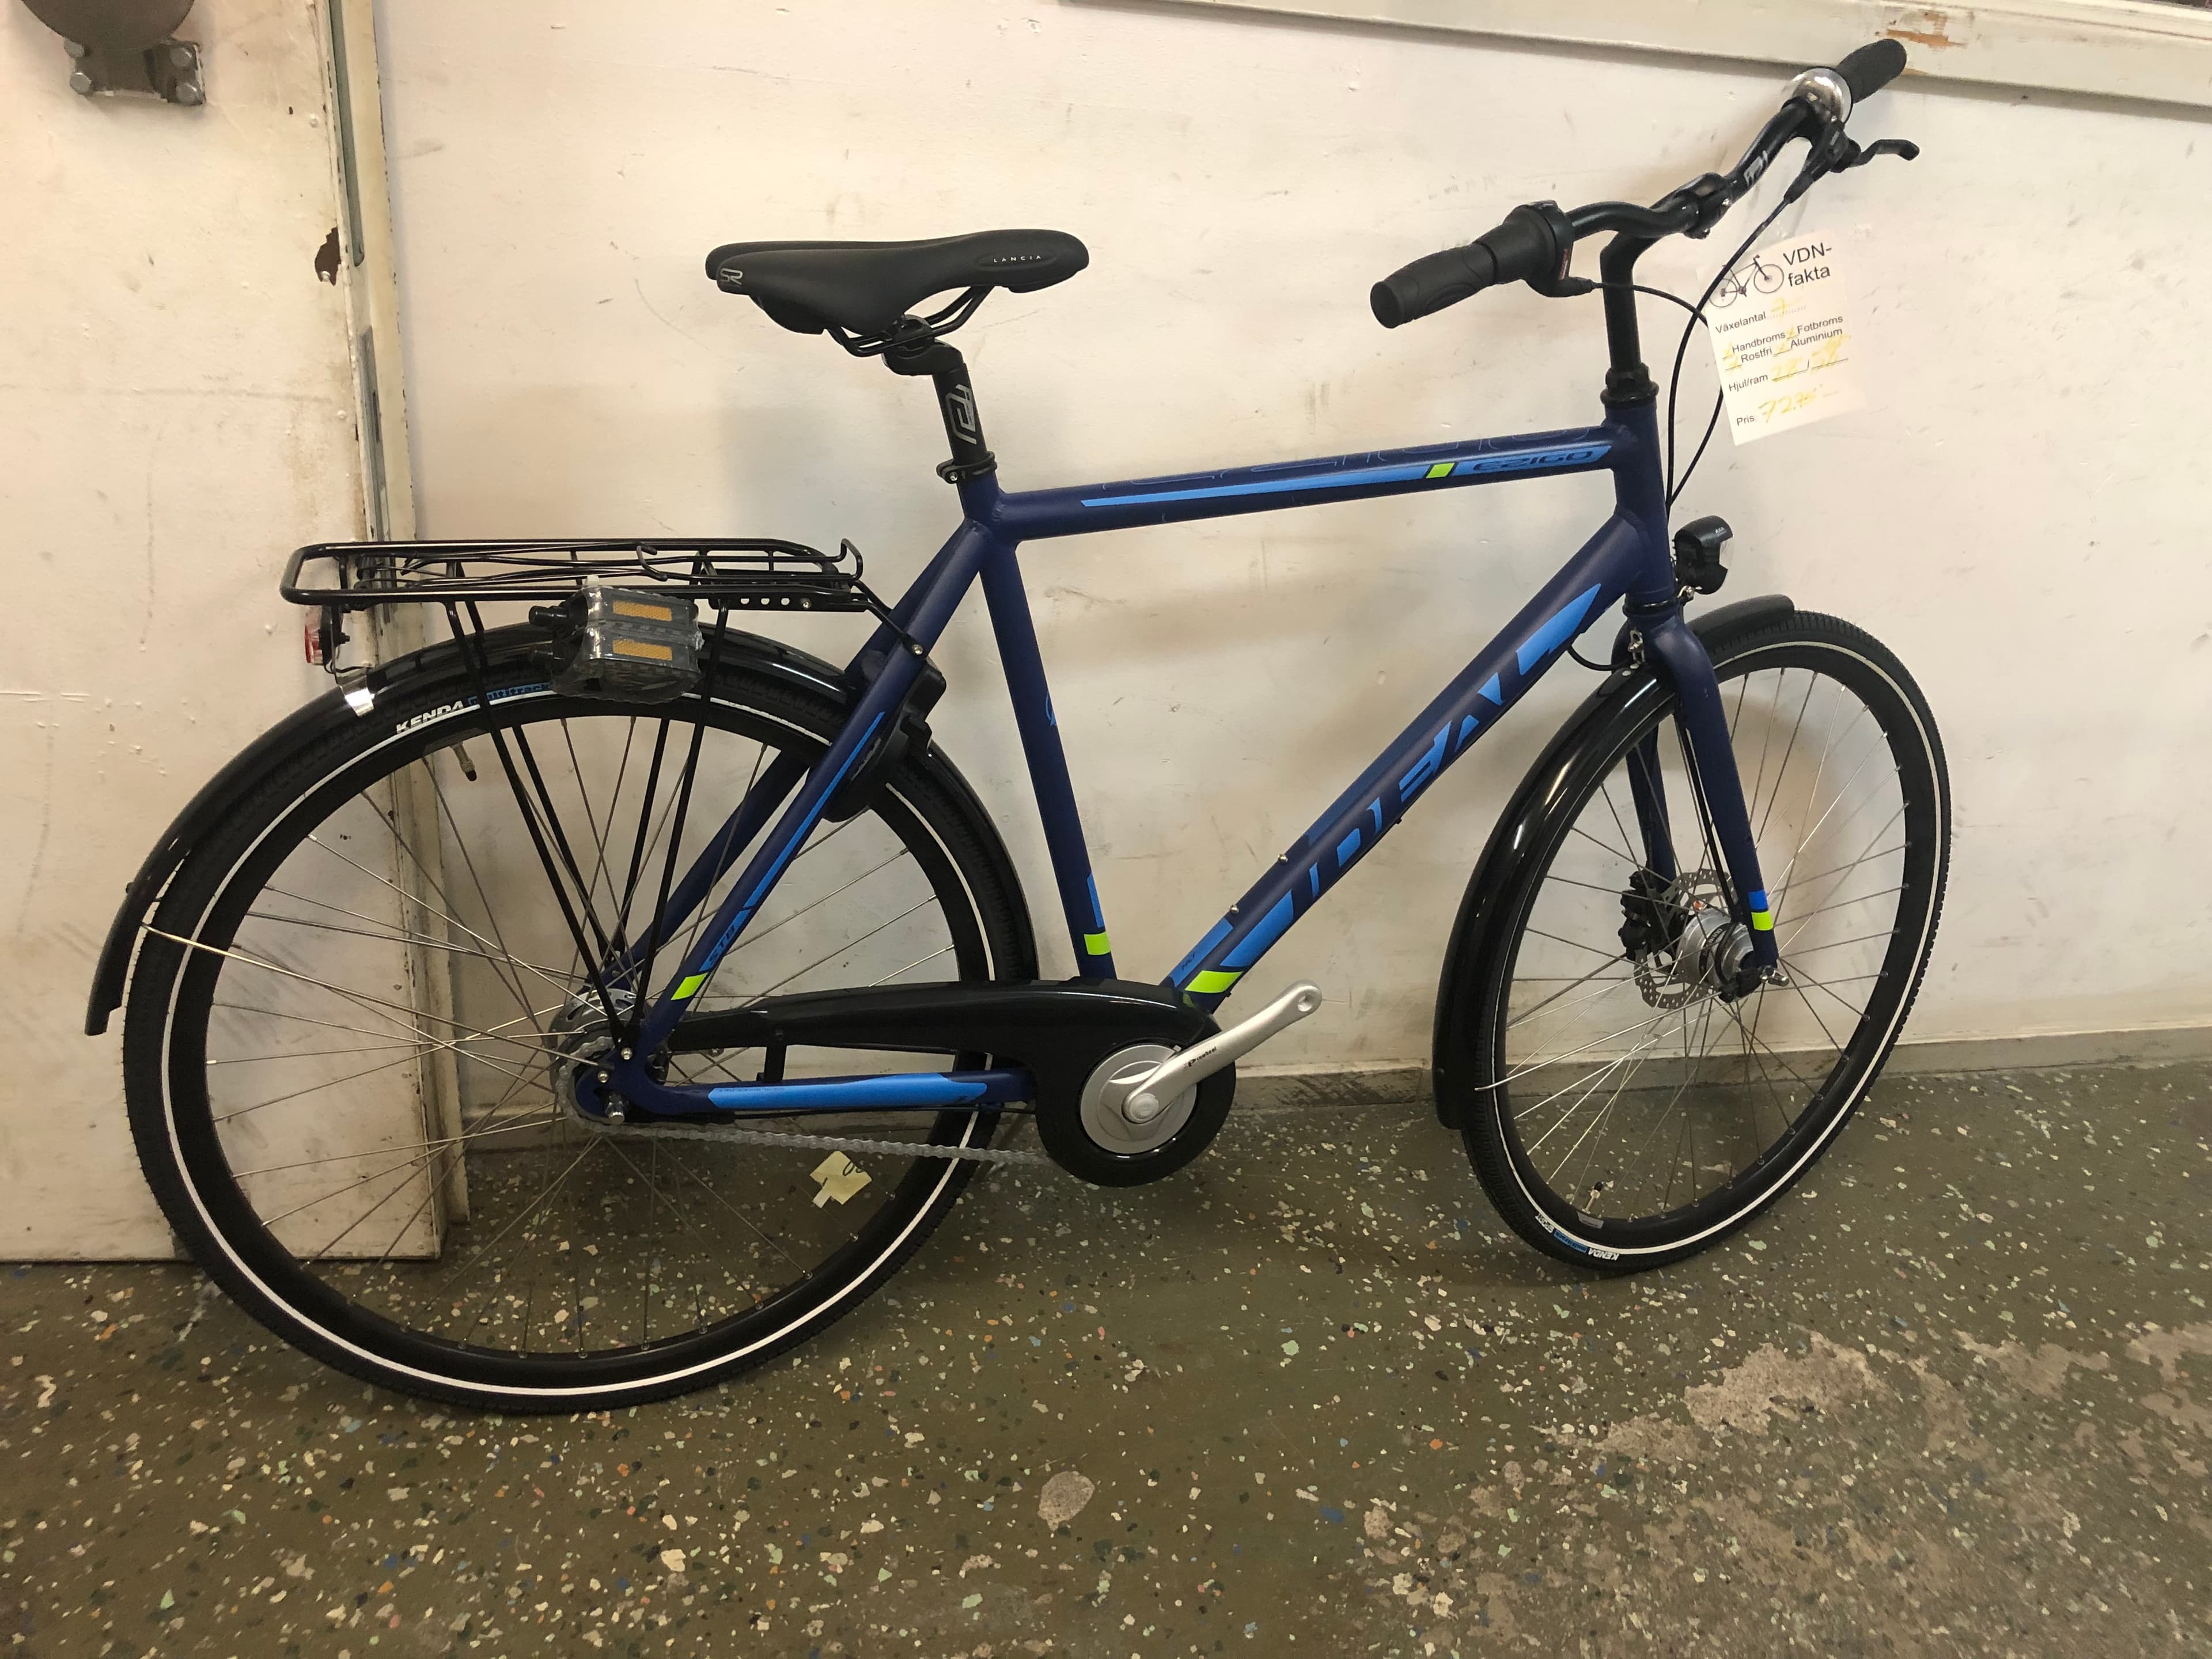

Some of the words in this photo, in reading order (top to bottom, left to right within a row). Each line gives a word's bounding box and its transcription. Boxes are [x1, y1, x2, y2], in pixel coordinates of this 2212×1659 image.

[993, 253, 1043, 263] LANCIA
[1783, 242, 1832, 266] VDN-
[1787, 266, 1831, 287] fakta
[1715, 312, 1767, 334] Växelantal
[1732, 331, 1786, 354] Handbroms
[1797, 315, 1844, 334] Fotbroms
[1741, 347, 1772, 363] Rostfri
[1790, 328, 1843, 350] Aluminium
[1728, 374, 1768, 392] Hjul/ram
[397, 700, 464, 734] KENDA
[1588, 1248, 1620, 1261] KENDA
